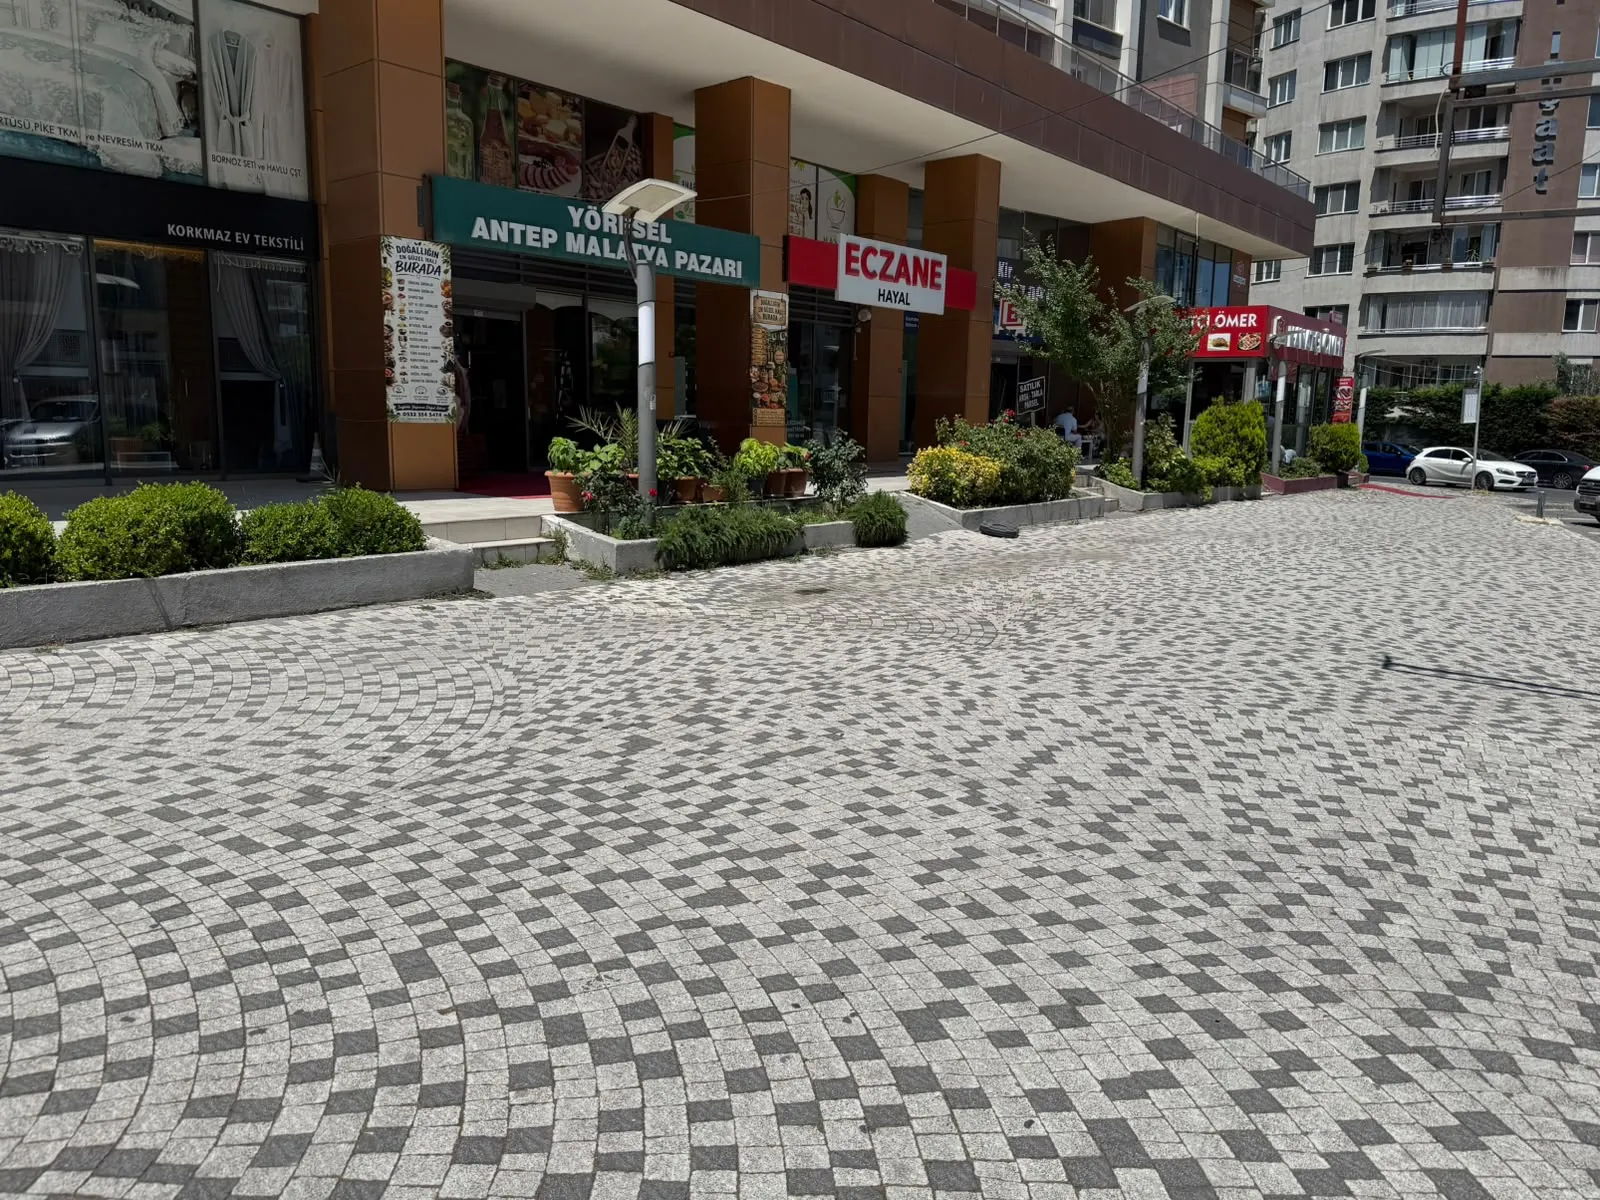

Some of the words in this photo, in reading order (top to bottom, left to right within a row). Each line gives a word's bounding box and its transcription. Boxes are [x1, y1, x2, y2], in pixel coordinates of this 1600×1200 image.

[97, 134, 143, 149] NEVRESİM
[211, 154, 242, 167] BORNOZ
[266, 164, 288, 175] HAVLU
[167, 223, 231, 242] KORKMAZ
[235, 231, 250, 244] EV
[254, 234, 304, 251] TEKSTİLİ
[471, 216, 558, 249] ANTEP
[565, 232, 669, 268] MALATYA
[674, 251, 742, 279] PAZARI
[395, 260, 442, 276] BURADA
[844, 241, 943, 291] ECZANE
[877, 288, 911, 306] HAYAL
[1214, 310, 1257, 328] ÖMER
[1019, 380, 1041, 393] SATILIK
